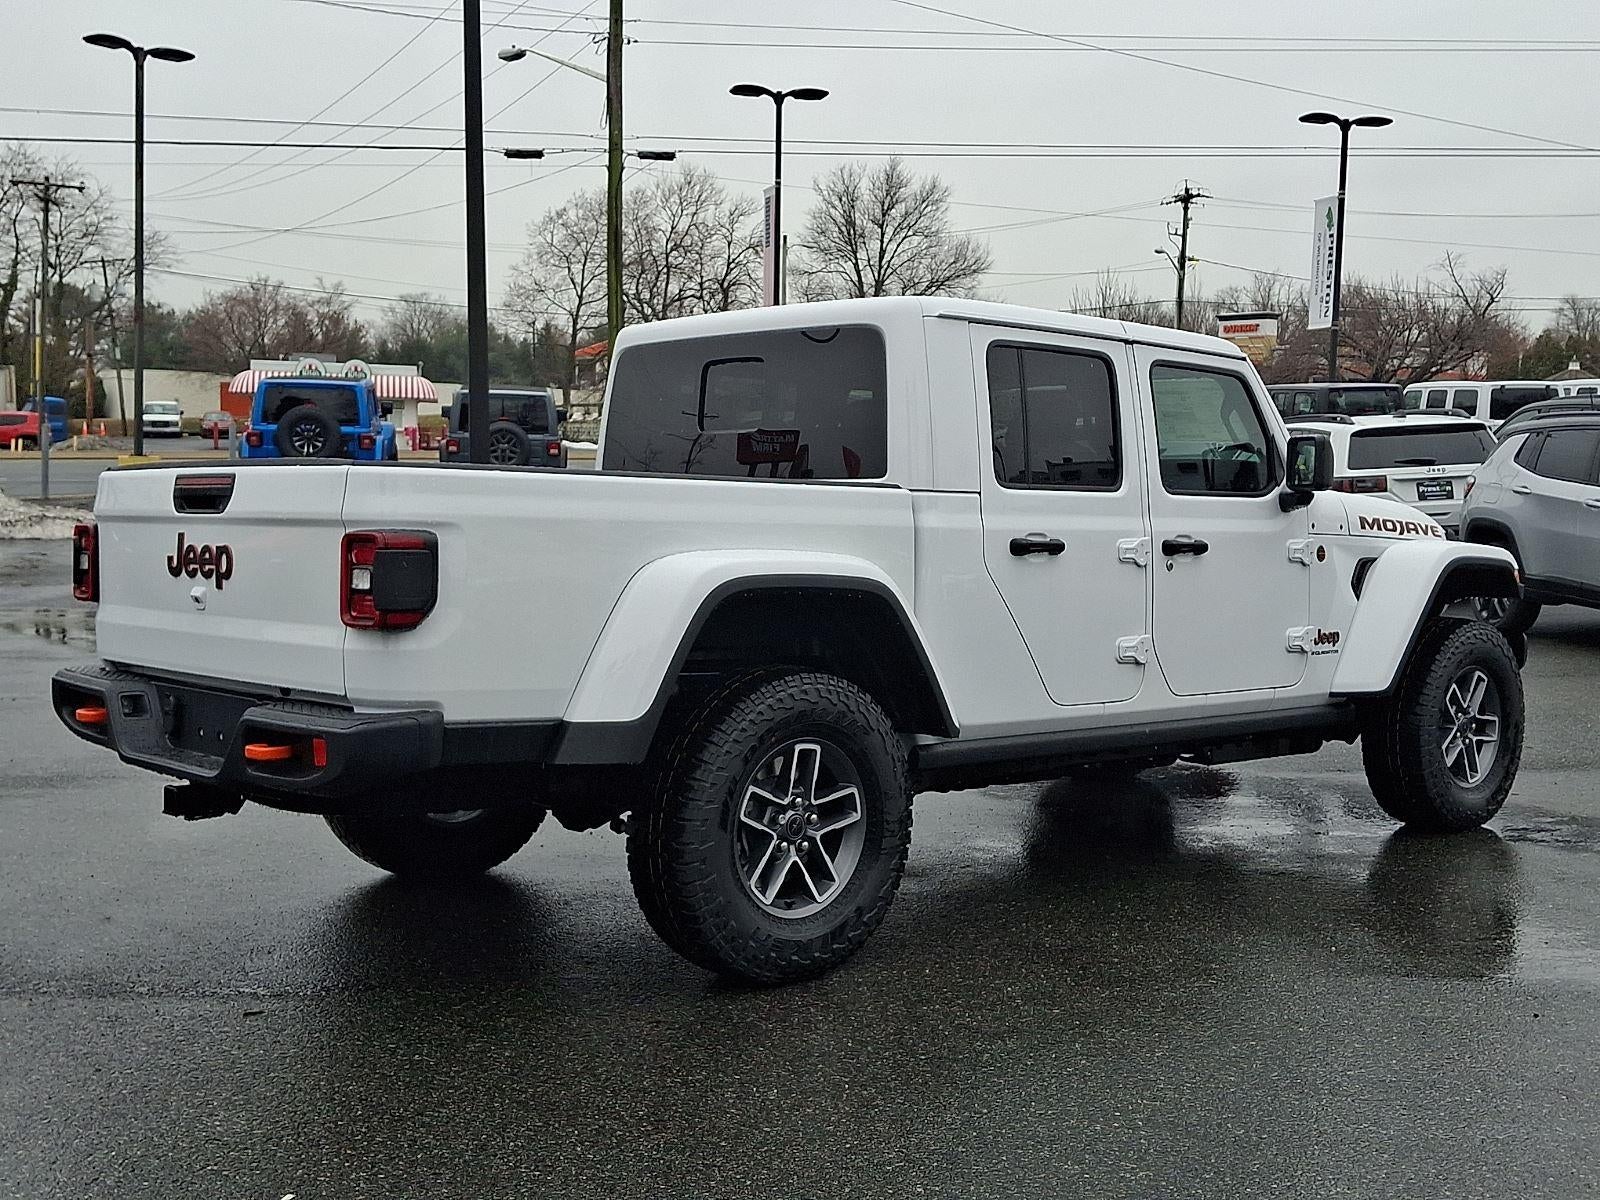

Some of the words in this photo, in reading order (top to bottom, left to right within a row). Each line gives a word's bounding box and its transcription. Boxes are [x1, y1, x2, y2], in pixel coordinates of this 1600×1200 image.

[1324, 233, 1335, 318] PRESTON
[1359, 516, 1442, 537] MOJAVE
[167, 532, 234, 590] Jeep
[1314, 628, 1340, 647] Jeep
